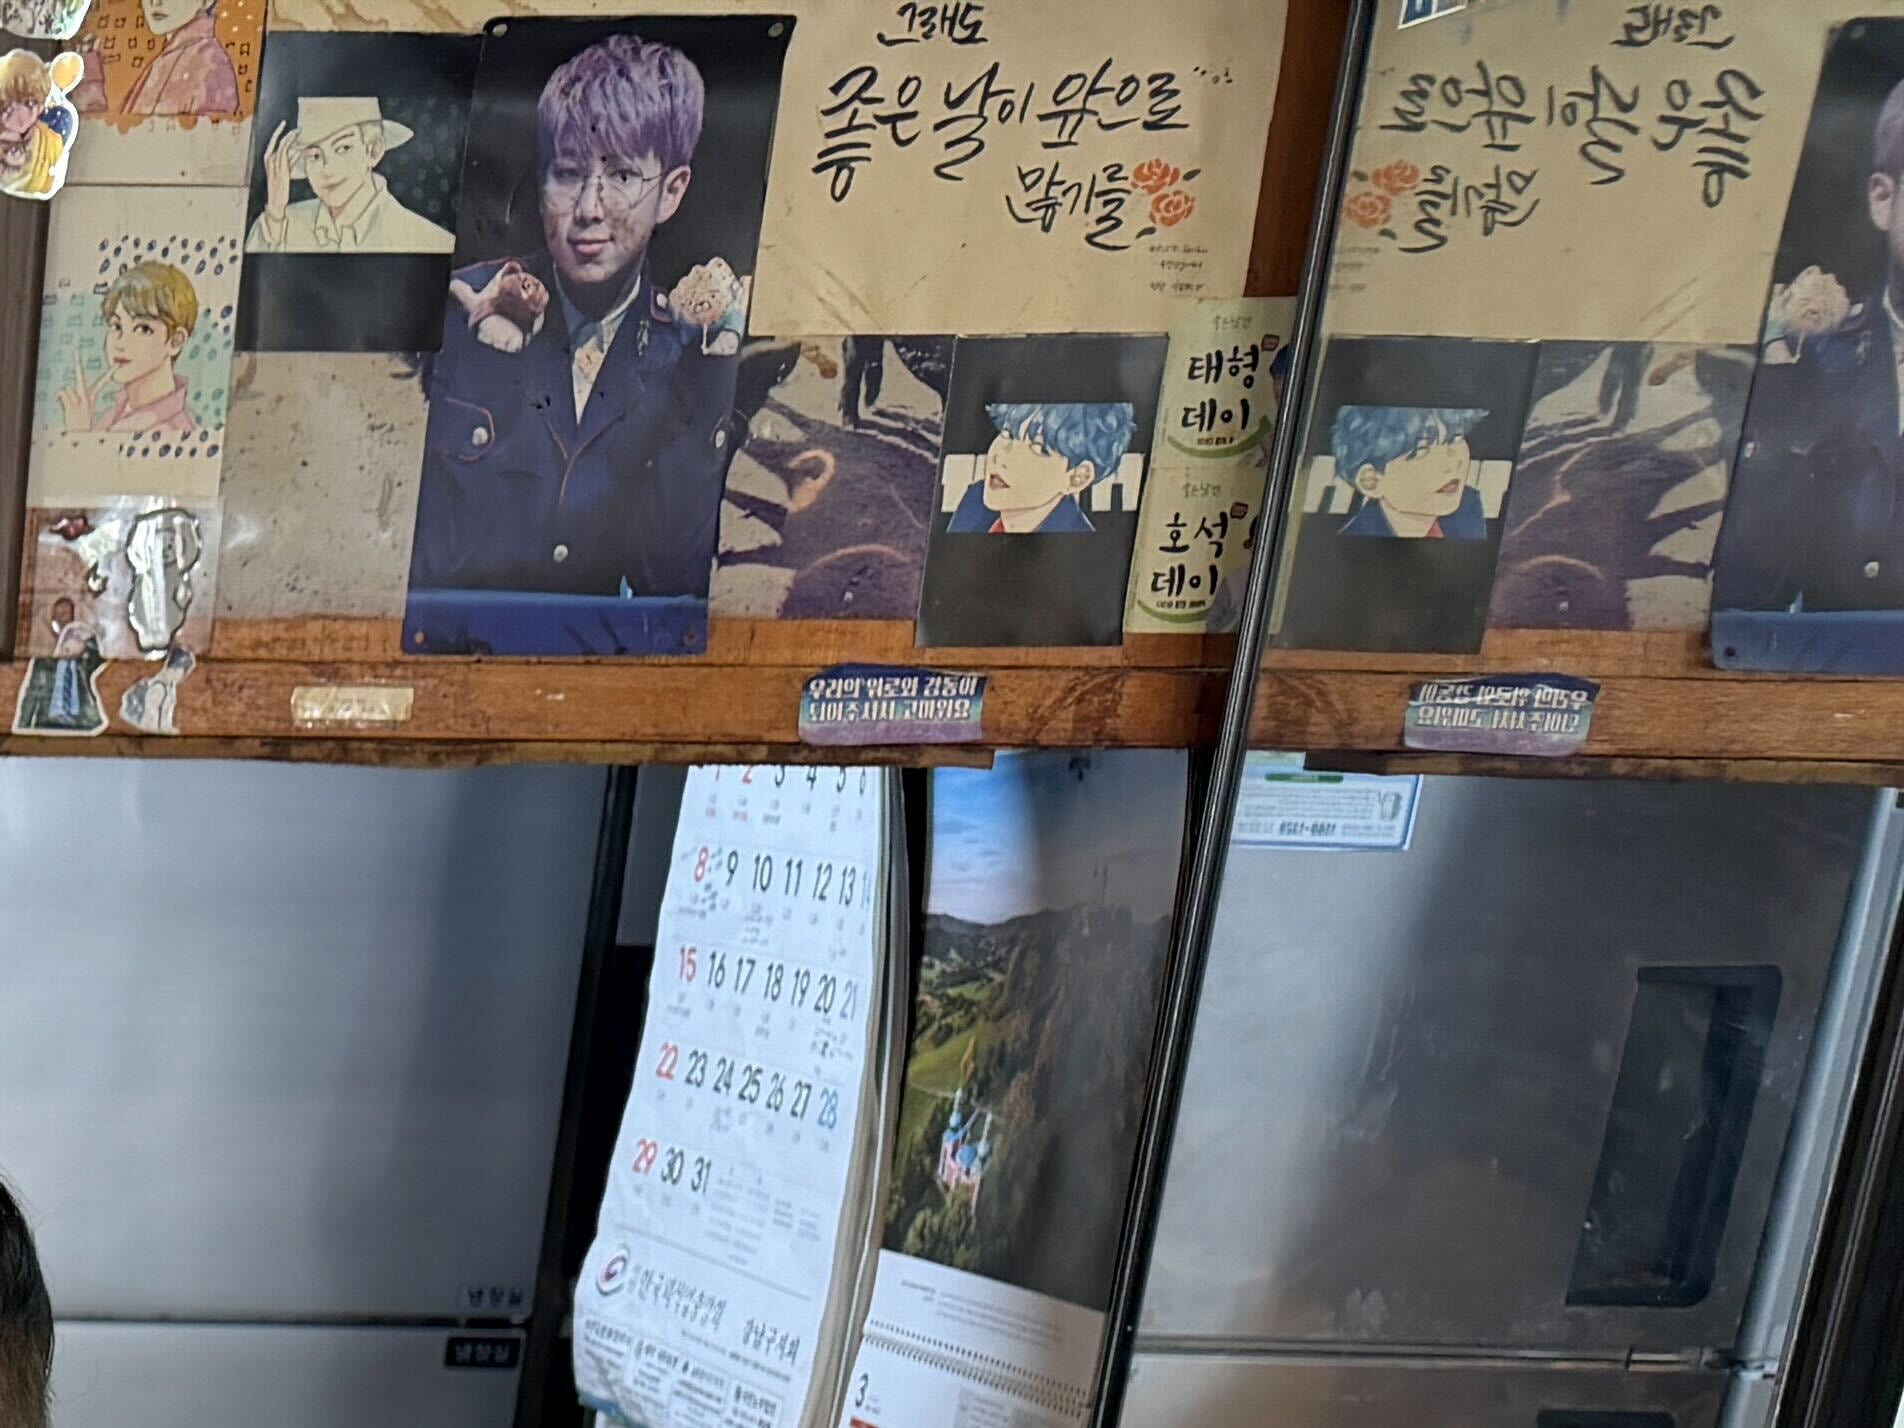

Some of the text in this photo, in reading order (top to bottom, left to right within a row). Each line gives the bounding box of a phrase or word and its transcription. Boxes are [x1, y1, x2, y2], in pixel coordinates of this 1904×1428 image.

[1188, 344, 1260, 390] 태형
[1181, 398, 1251, 432] 데이
[1159, 511, 1229, 559] 호석
[1151, 563, 1219, 597] 데이
[694, 846, 856, 907] 8 9 10 11 12 13
[707, 950, 726, 989] 16
[734, 957, 756, 995] 17
[764, 961, 784, 1002] 18
[656, 1042, 679, 1081] 22
[685, 1047, 708, 1088] 23
[713, 1056, 735, 1096] 24
[691, 1156, 712, 1195] 31
[855, 1373, 868, 1408] 3
